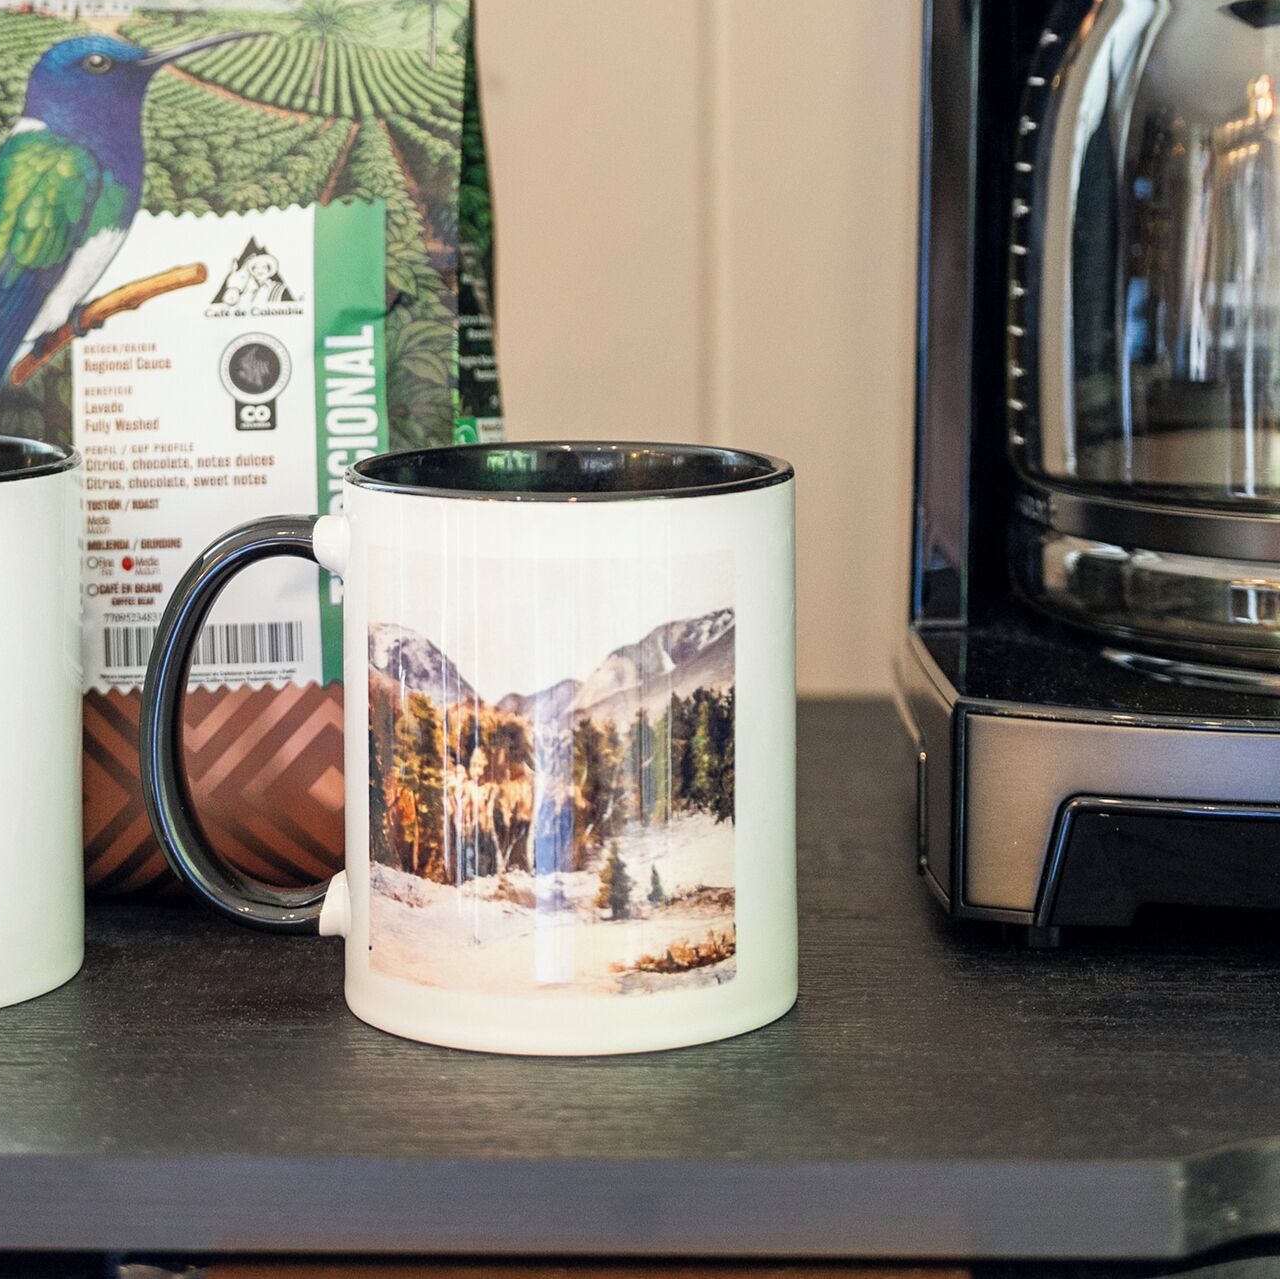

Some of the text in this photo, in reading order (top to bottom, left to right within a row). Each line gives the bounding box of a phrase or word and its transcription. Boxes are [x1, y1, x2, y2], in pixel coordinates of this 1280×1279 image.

[250, 306, 304, 318] Colombia
[84, 357, 172, 374] Regional Cauca
[85, 401, 124, 415] Lavado
[85, 417, 160, 434] Fully Washed
[197, 455, 231, 468] notas
[235, 453, 276, 466] dulces
[193, 473, 229, 487] sweet
[233, 472, 268, 486] notes
